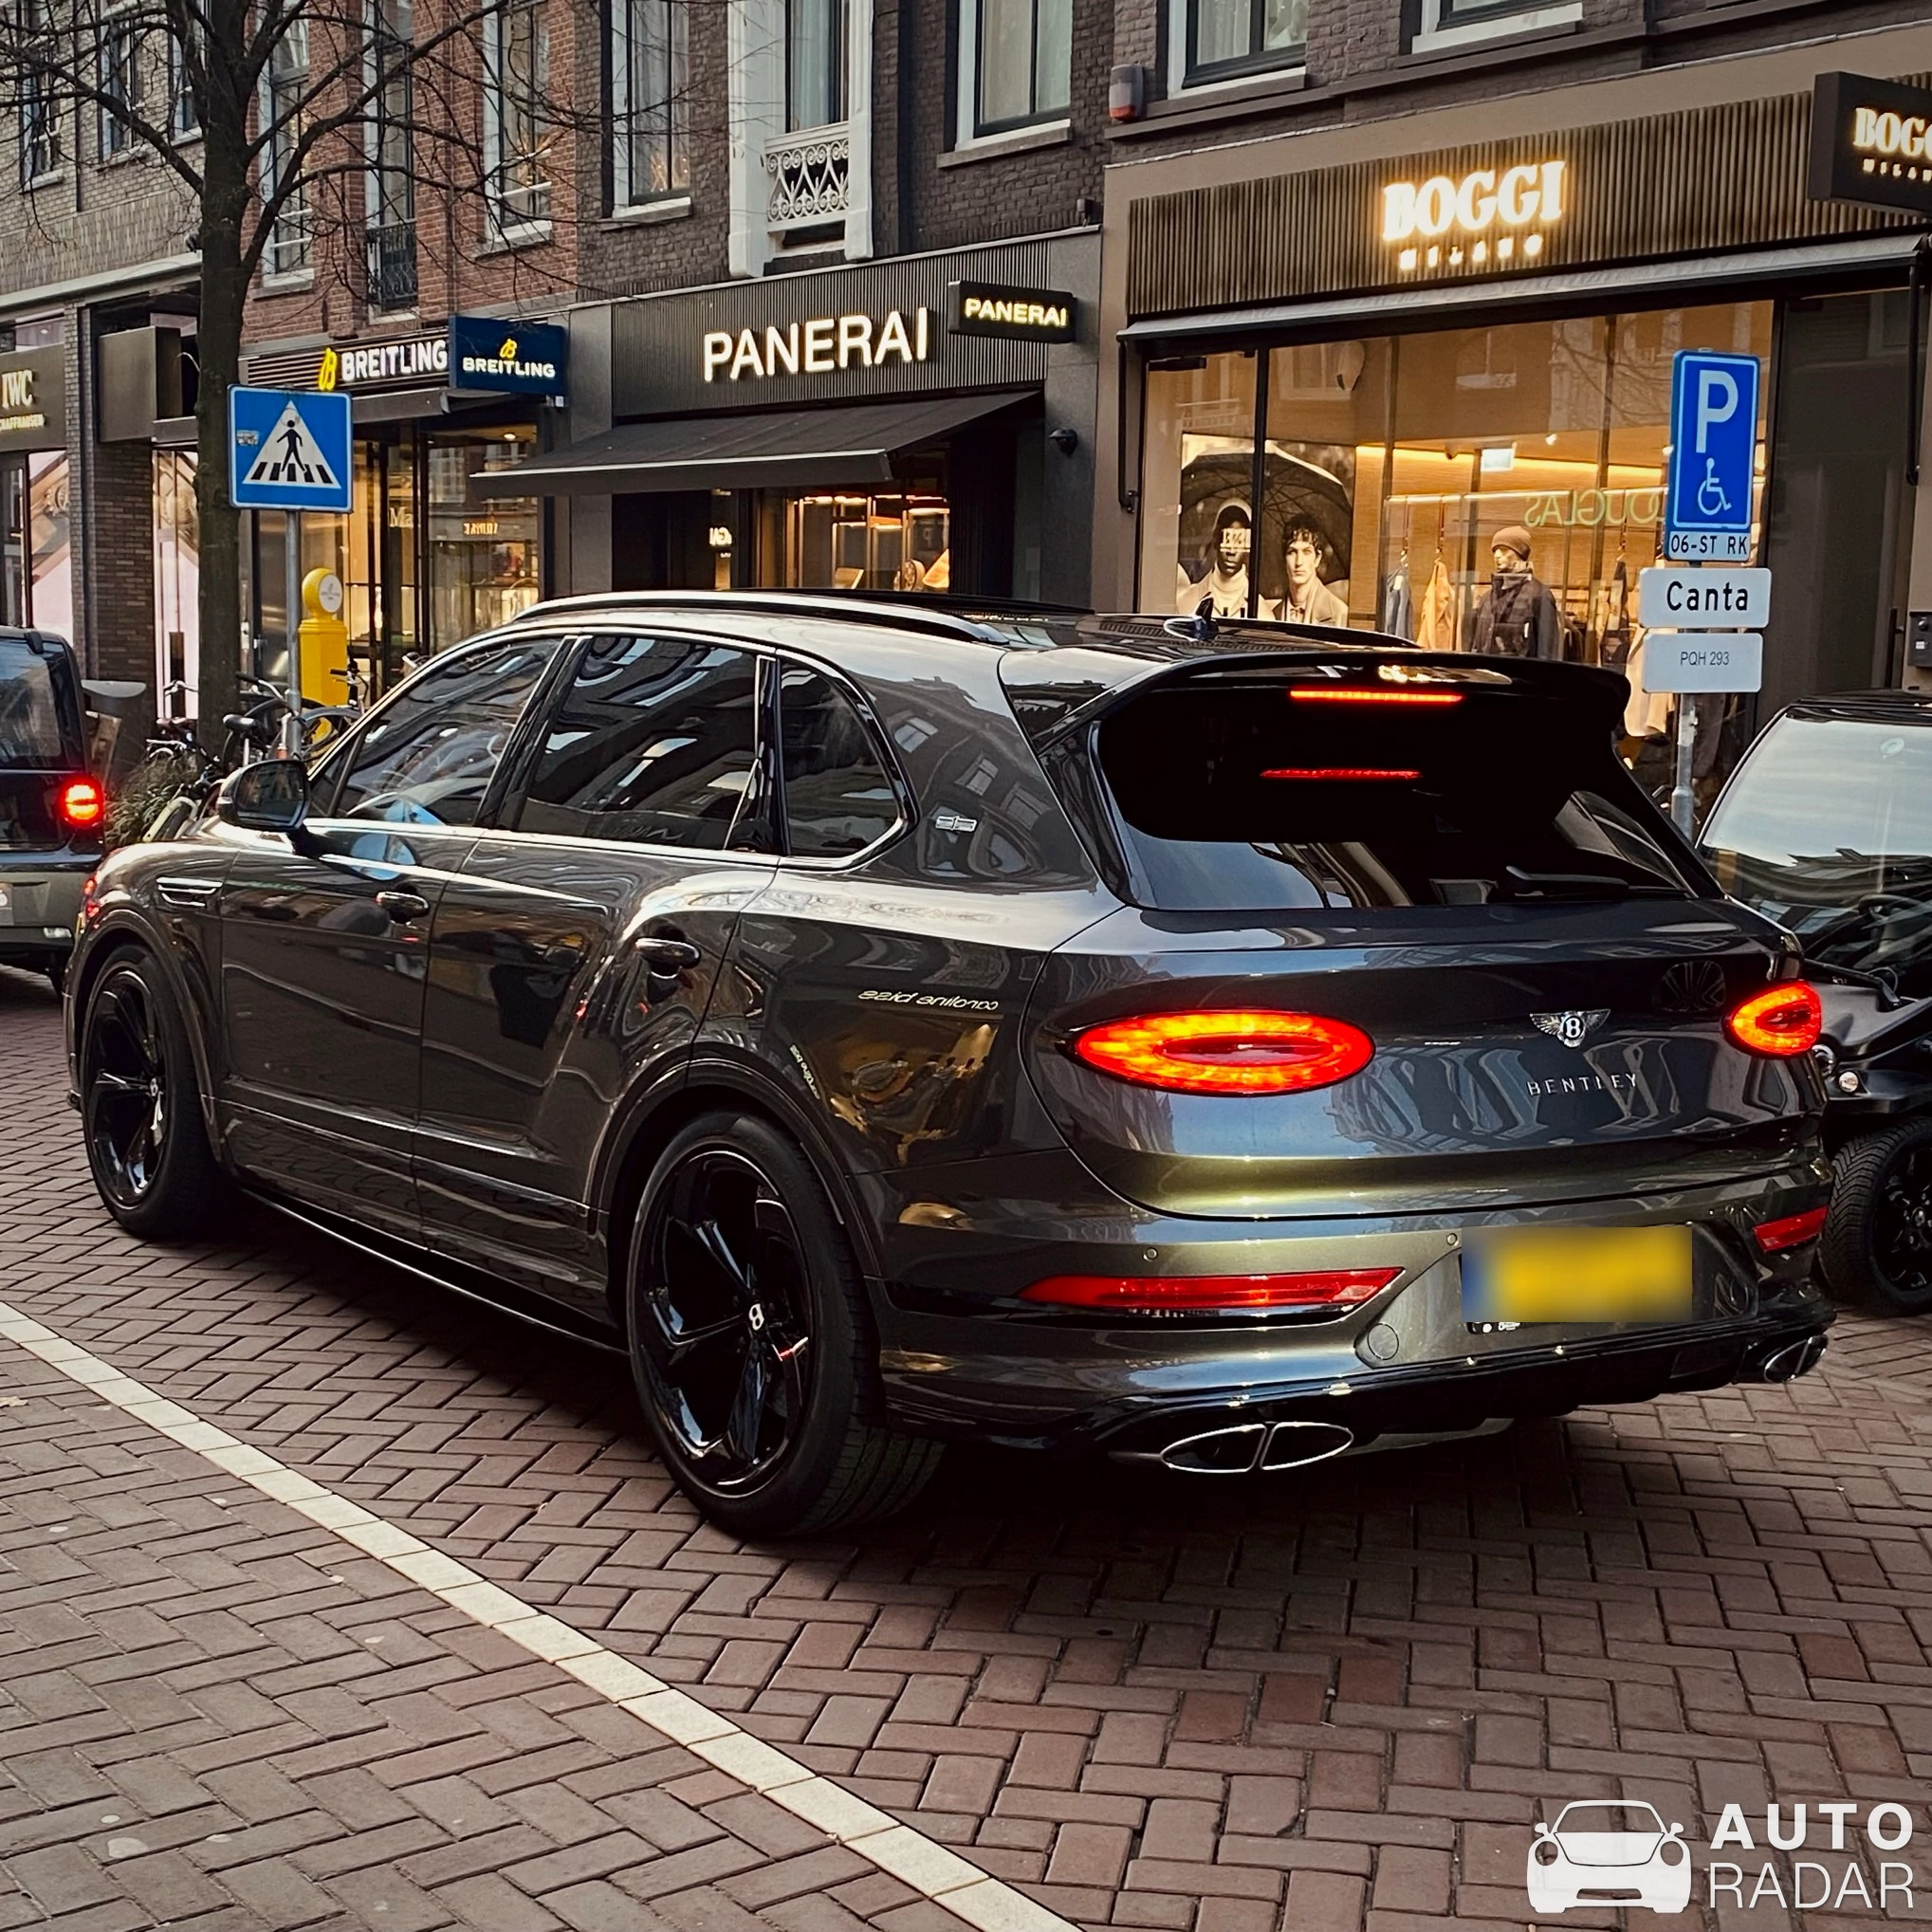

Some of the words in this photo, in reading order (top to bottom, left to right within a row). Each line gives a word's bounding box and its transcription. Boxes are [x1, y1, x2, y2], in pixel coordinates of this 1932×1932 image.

[1853, 107, 1932, 162] BOG
[1382, 160, 1565, 242] BOGGI
[963, 298, 1068, 327] PANERAI
[340, 340, 448, 382] BREITLING
[704, 306, 928, 382] PANERAI
[462, 357, 556, 378] BREITLING
[2, 369, 33, 411] IWC
[1696, 369, 1739, 453] P
[1670, 534, 1718, 554] 06-ST
[1727, 536, 1747, 555] RK
[1666, 580, 1749, 612] Canta
[1680, 651, 1706, 666] PQH
[1709, 651, 1730, 666] 293
[1527, 1073, 1636, 1096] BENTLEY
